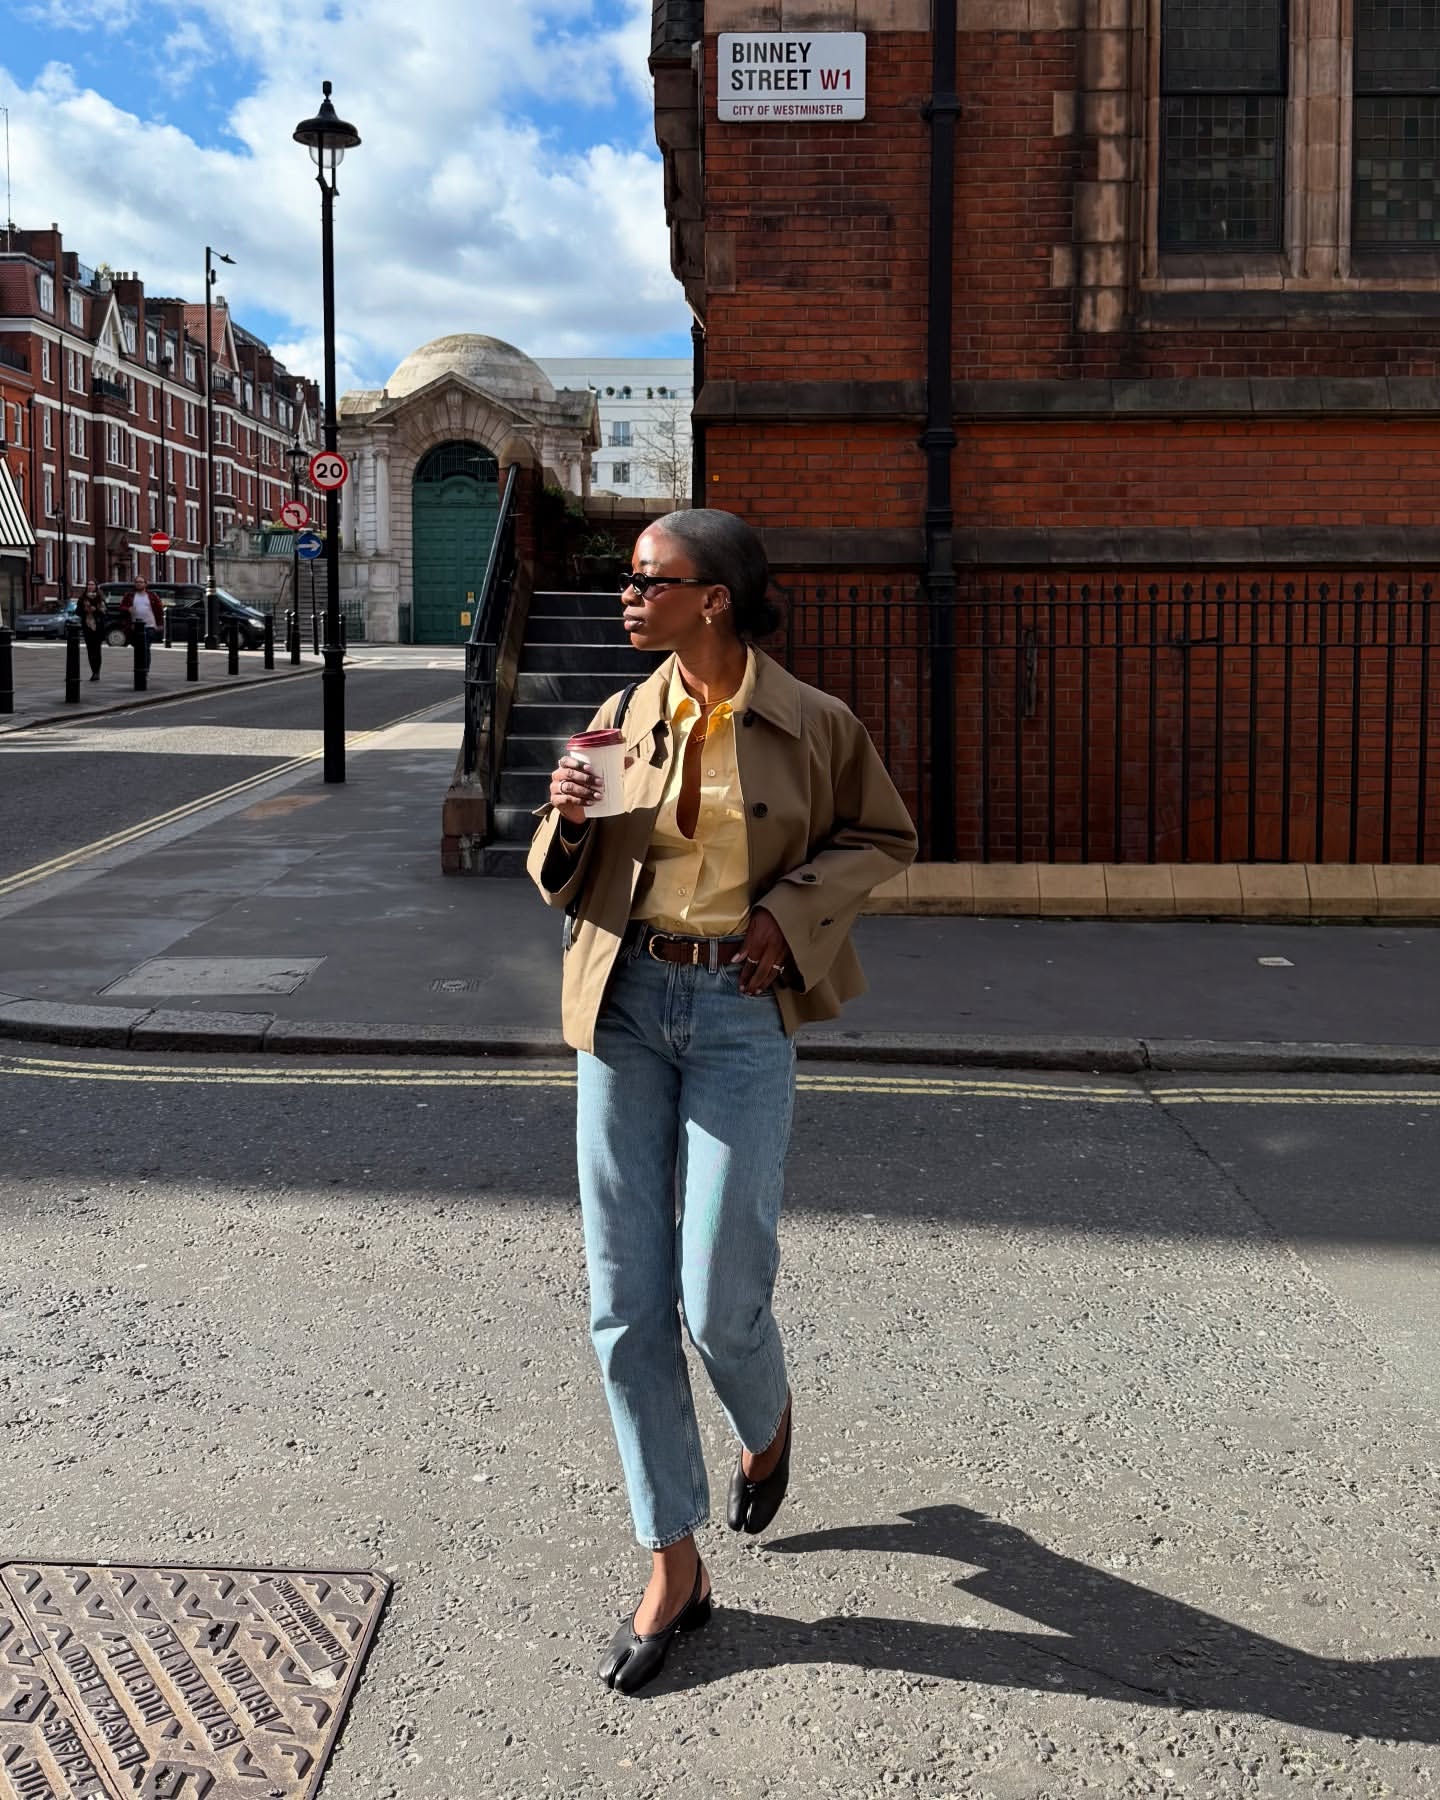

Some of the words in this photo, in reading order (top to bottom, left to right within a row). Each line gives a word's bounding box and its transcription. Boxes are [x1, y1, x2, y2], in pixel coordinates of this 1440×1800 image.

[732, 42, 812, 63] BINNEY
[731, 69, 811, 91] STREET
[820, 69, 851, 90] W1
[732, 105, 754, 115] CITY
[757, 105, 770, 115] OF
[773, 104, 843, 115] WESTMINSTER
[316, 462, 343, 479] 20
[269, 1603, 285, 1614] 3
[273, 1579, 348, 1661] COMMUNICATIONS
[144, 1626, 185, 1661] PLC
[276, 1611, 311, 1647] LEVEL
[62, 1650, 105, 1694] E600
[102, 1640, 173, 1724] DUCTILE
[165, 1660, 239, 1744] STANTON
